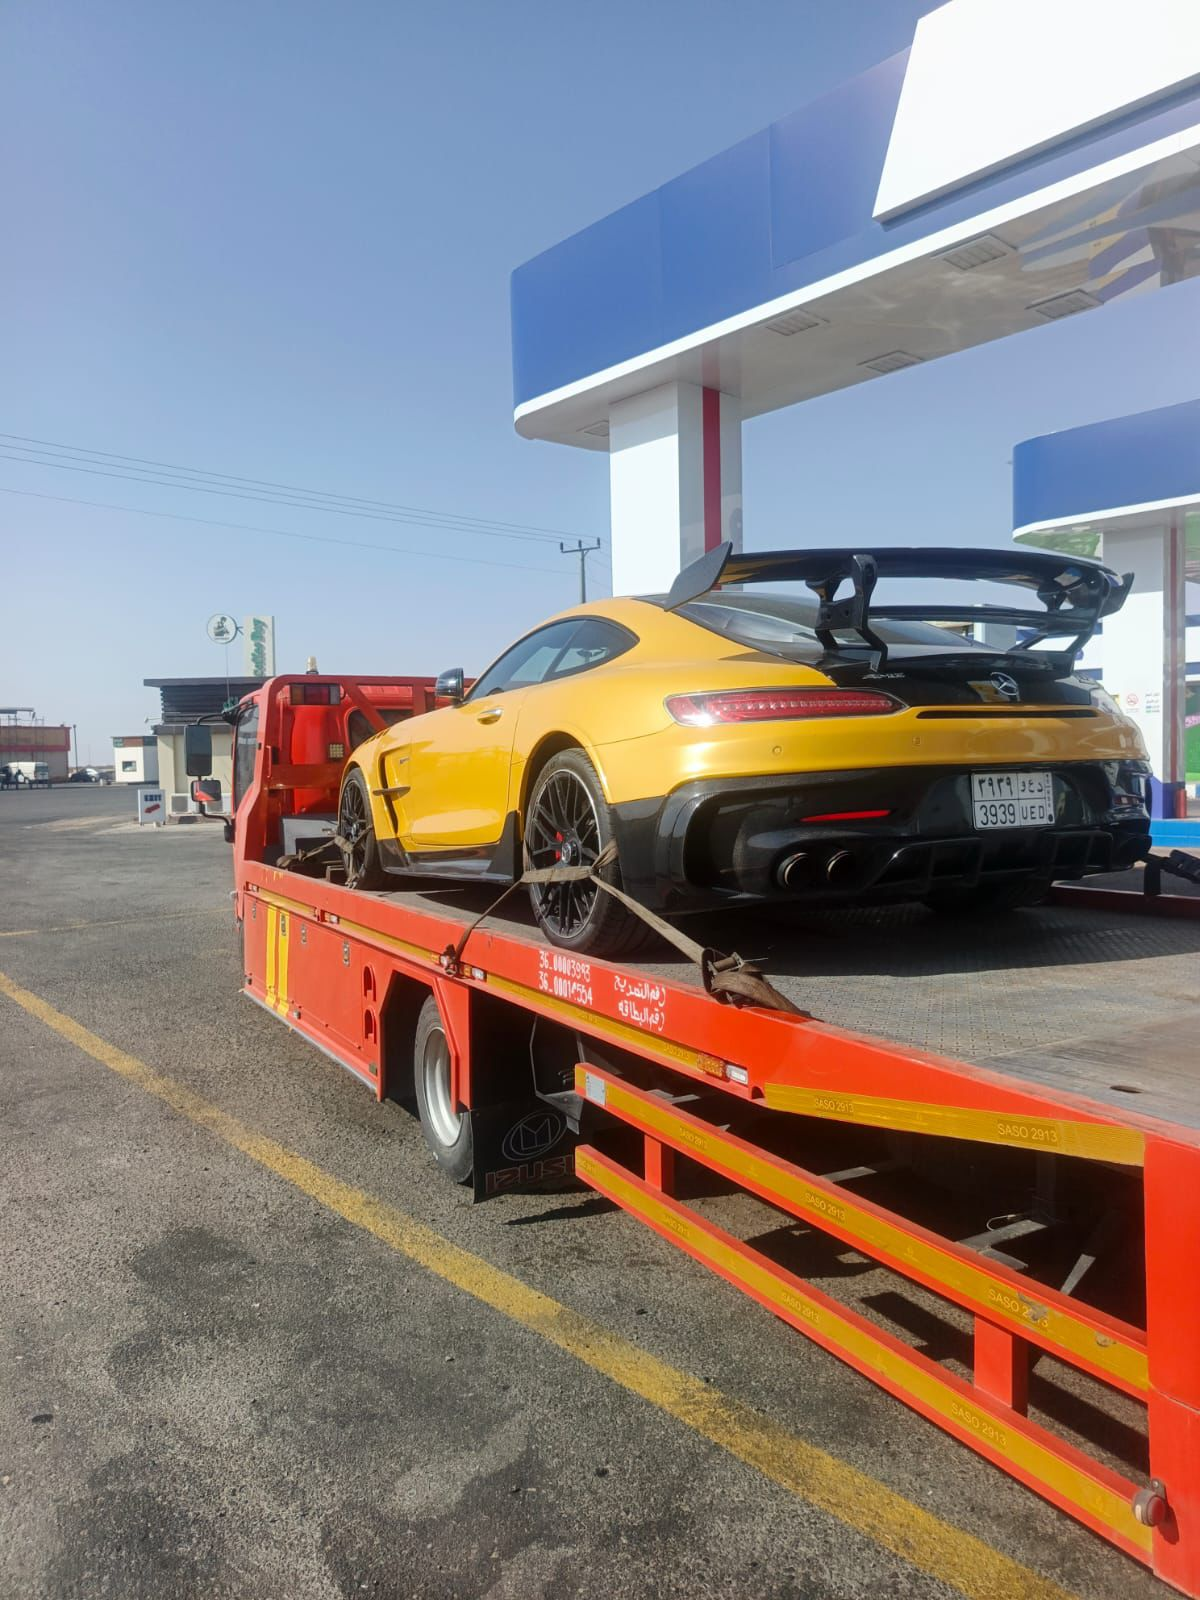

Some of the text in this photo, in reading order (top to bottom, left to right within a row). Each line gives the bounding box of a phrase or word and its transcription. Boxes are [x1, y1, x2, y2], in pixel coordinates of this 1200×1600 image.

[978, 776, 1014, 798] ٣٩٣٩
[979, 803, 1045, 825] 3939 UED
[814, 1098, 855, 1113] SASO 2913
[997, 1123, 1058, 1142] SASO 2913
[805, 1193, 846, 1220] SASO 2913
[782, 1292, 820, 1323] SASO 2913
[988, 1289, 1019, 1312] SASO
[952, 1402, 1007, 1446] SASO 2913
